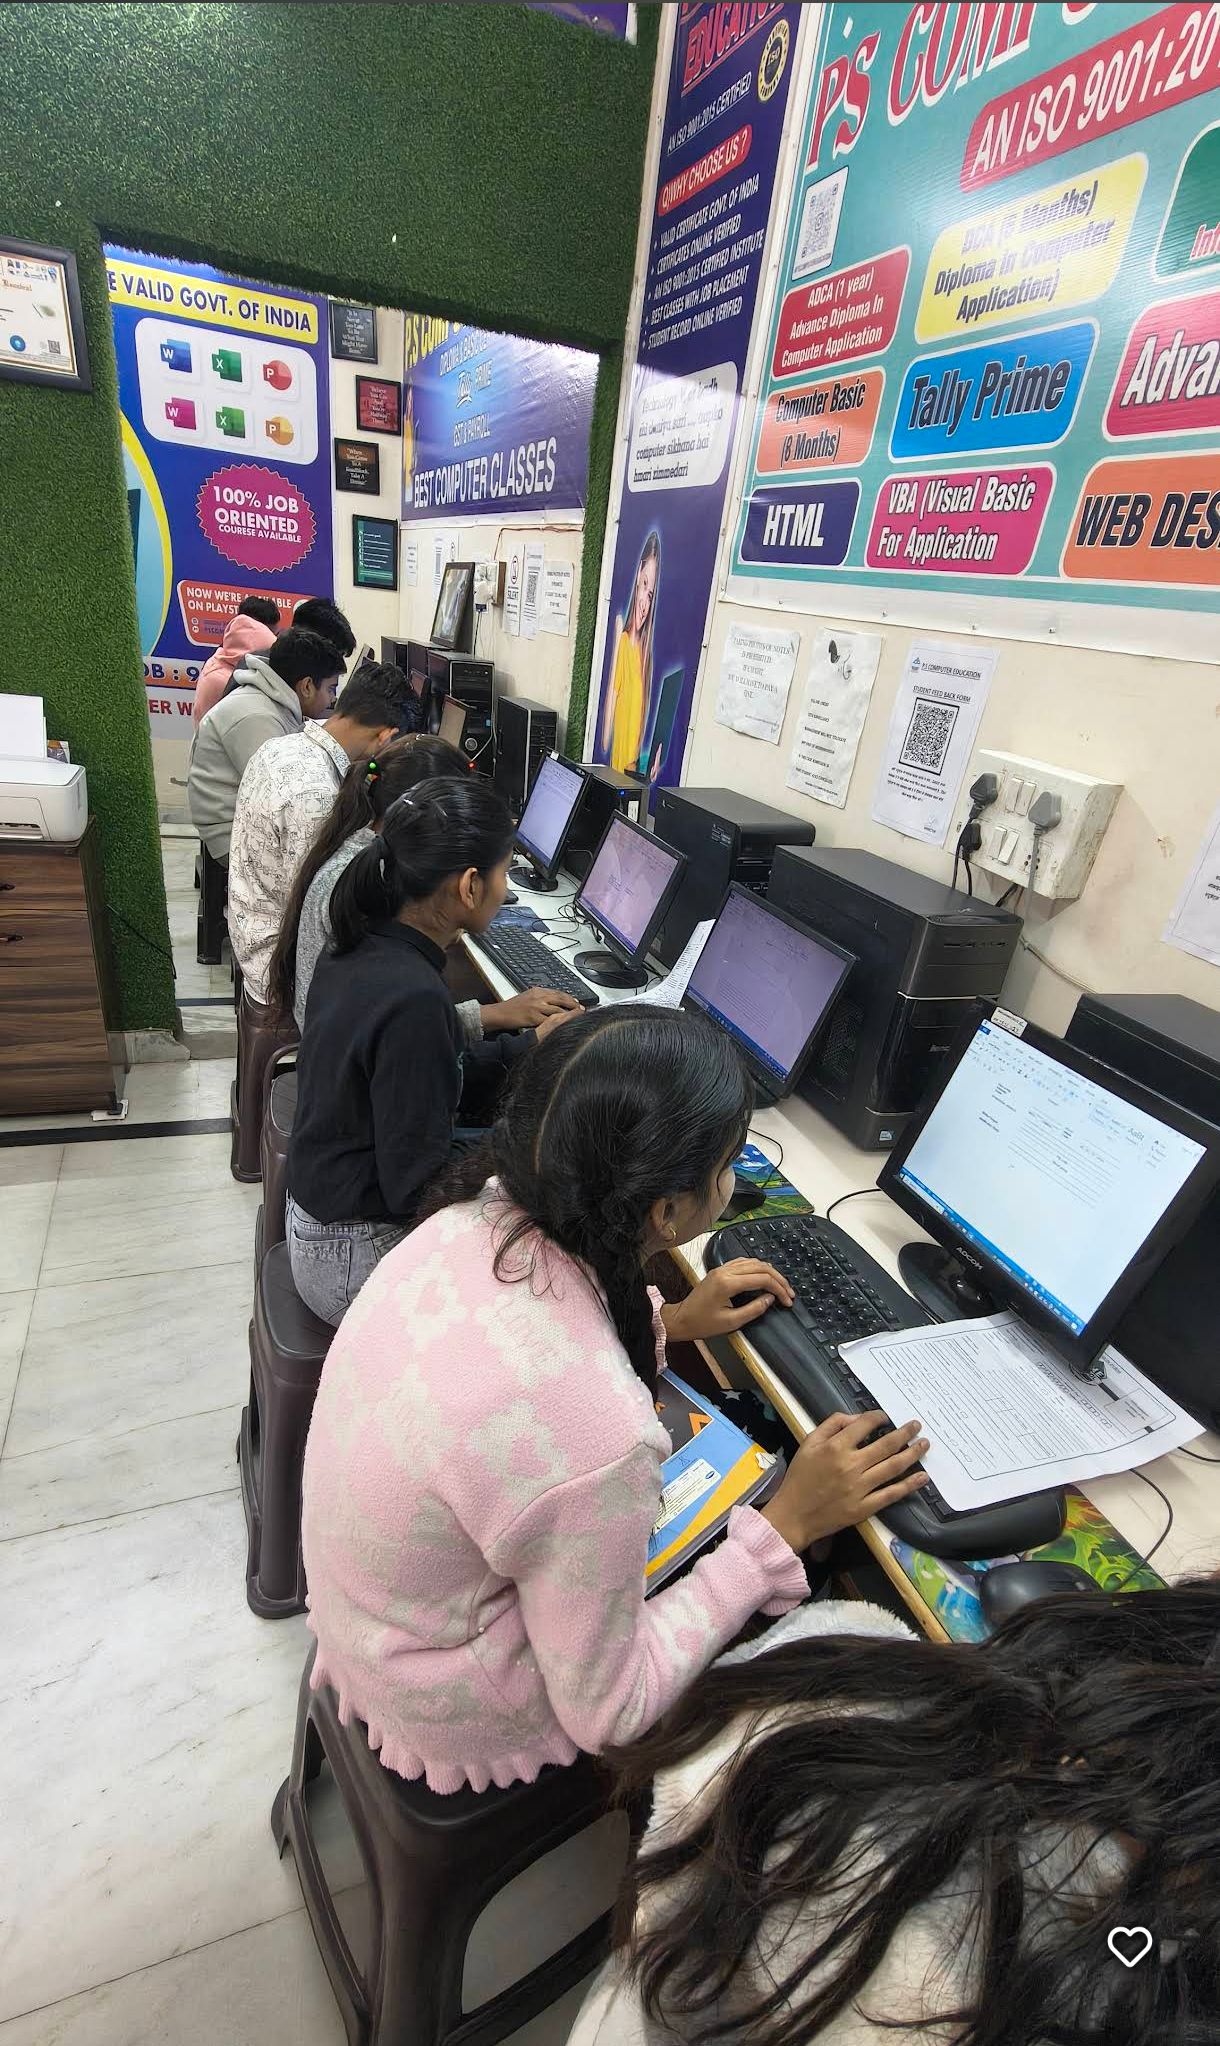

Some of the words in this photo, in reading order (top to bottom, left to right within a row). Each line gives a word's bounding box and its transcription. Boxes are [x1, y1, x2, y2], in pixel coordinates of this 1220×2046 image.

[667, 133, 676, 153] AN
[676, 124, 687, 146] ISO
[715, 71, 752, 115] CERTIFIED
[970, 102, 1018, 179] AN
[1016, 74, 1077, 156] ISO
[1076, 5, 1220, 131] 9001:20
[690, 145, 725, 191] CHOOSE
[725, 134, 740, 164] US
[742, 129, 748, 154] ?
[660, 226, 676, 250] VALID
[676, 205, 709, 241] CERTIFICATE
[728, 187, 739, 207] OF
[738, 173, 760, 203] INDIA
[1020, 180, 1099, 235] Months)
[690, 229, 714, 258] ONLINE
[713, 213, 742, 245] VERIFIED
[934, 259, 996, 297] Diploma
[1020, 218, 1117, 268] Computer
[662, 277, 672, 297] ISO
[700, 247, 730, 278] CERTIFIED
[729, 228, 765, 260] INSTITUTE
[121, 273, 175, 303] VALID
[179, 286, 234, 317] GOVT.
[238, 299, 260, 321] OF
[265, 304, 312, 333] INDIA
[650, 306, 664, 326] BEST
[663, 295, 685, 320] CLASSES
[684, 290, 700, 311] WITH
[698, 282, 712, 304] JOB
[711, 264, 750, 298] PLACEMENT
[807, 281, 835, 310] ADCA
[835, 278, 846, 302] (1
[847, 266, 875, 300] year)
[956, 268, 1061, 324] Application)
[648, 325, 671, 350] STUDENT
[670, 316, 691, 341] RECORD
[692, 308, 715, 332] ONLINE
[715, 296, 743, 323] VERIFIED
[789, 315, 828, 341] Advance
[829, 302, 871, 331] Diploma
[872, 294, 884, 314] In
[781, 343, 824, 368] Computer
[824, 325, 884, 358] Application
[775, 390, 829, 425] Computer
[829, 377, 866, 413] Basic
[907, 367, 974, 438] Tally
[971, 354, 1072, 422] Prime
[793, 427, 842, 464] Months)
[414, 469, 434, 509] BEST
[434, 456, 488, 505] COMPUTER
[489, 436, 557, 499] CLASSES
[213, 485, 262, 509] 100%
[264, 494, 299, 514] JOB
[214, 507, 299, 535] ORIENTED
[887, 481, 919, 515] VBA
[919, 477, 980, 521] (Visual
[981, 473, 1038, 513] Basic
[1075, 493, 1153, 549] WEB
[1149, 490, 1220, 550] DES
[218, 524, 256, 538] COURESE
[257, 529, 302, 544] AVAILABLE
[762, 503, 825, 547] HTML
[876, 526, 903, 557] For
[903, 525, 1000, 566] Application
[186, 586, 212, 600] NOW
[214, 590, 242, 604] WE'RE
[187, 600, 204, 611] ON
[206, 602, 240, 615] PLAYST
[913, 685, 932, 694] STUDENT
[943, 691, 956, 700] BACK
[956, 694, 971, 703] FORM
[928, 664, 953, 675] COMPUTER
[952, 667, 982, 679] EDUCATION
[956, 1246, 984, 1272] ADCOM
